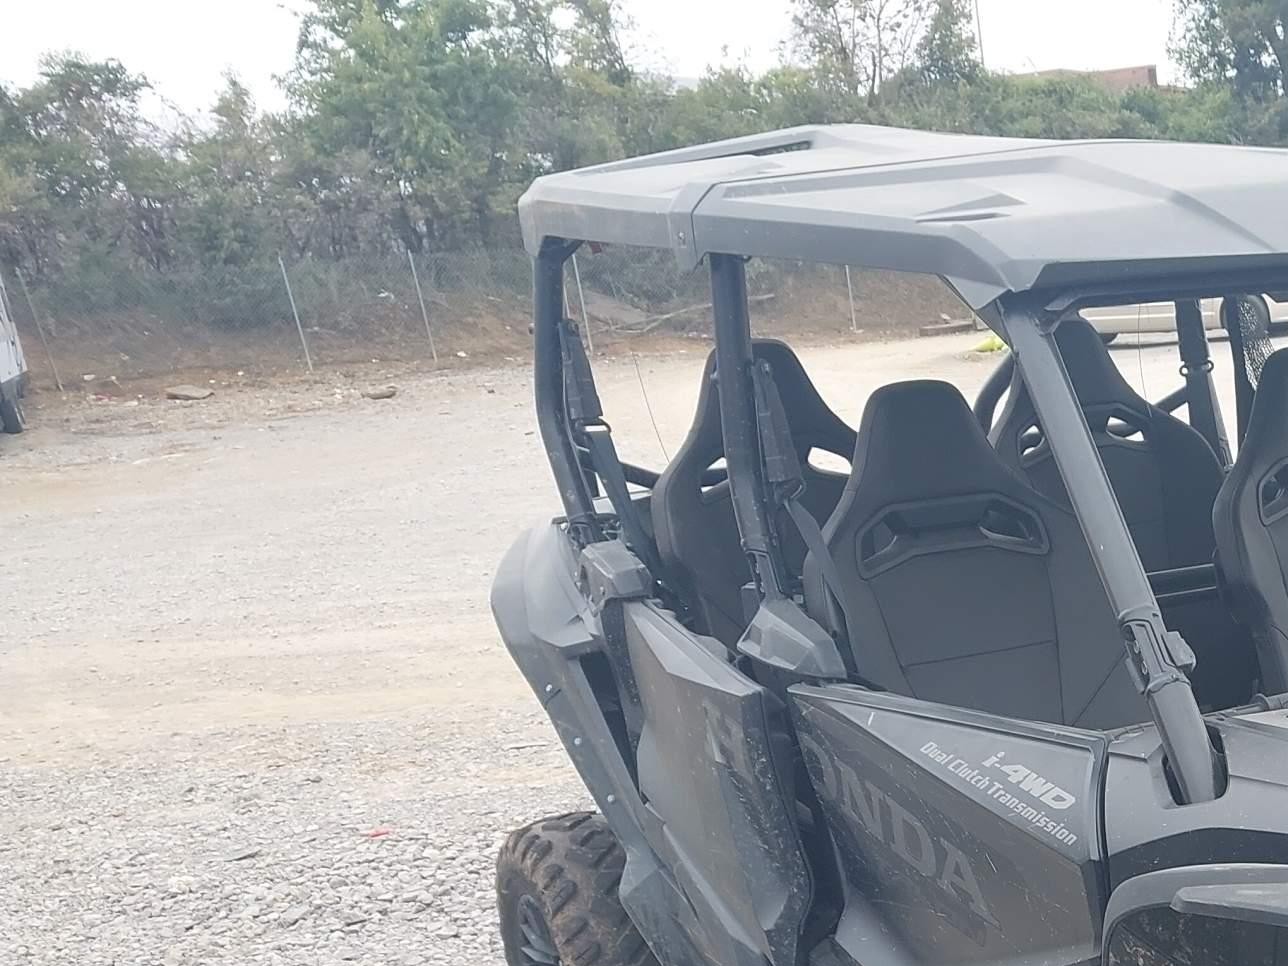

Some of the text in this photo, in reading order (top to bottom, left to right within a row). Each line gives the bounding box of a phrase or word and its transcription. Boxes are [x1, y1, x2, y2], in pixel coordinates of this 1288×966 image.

[919, 741, 1078, 846] Dual Clutch Transmission
[982, 751, 1076, 810] i-4WD
